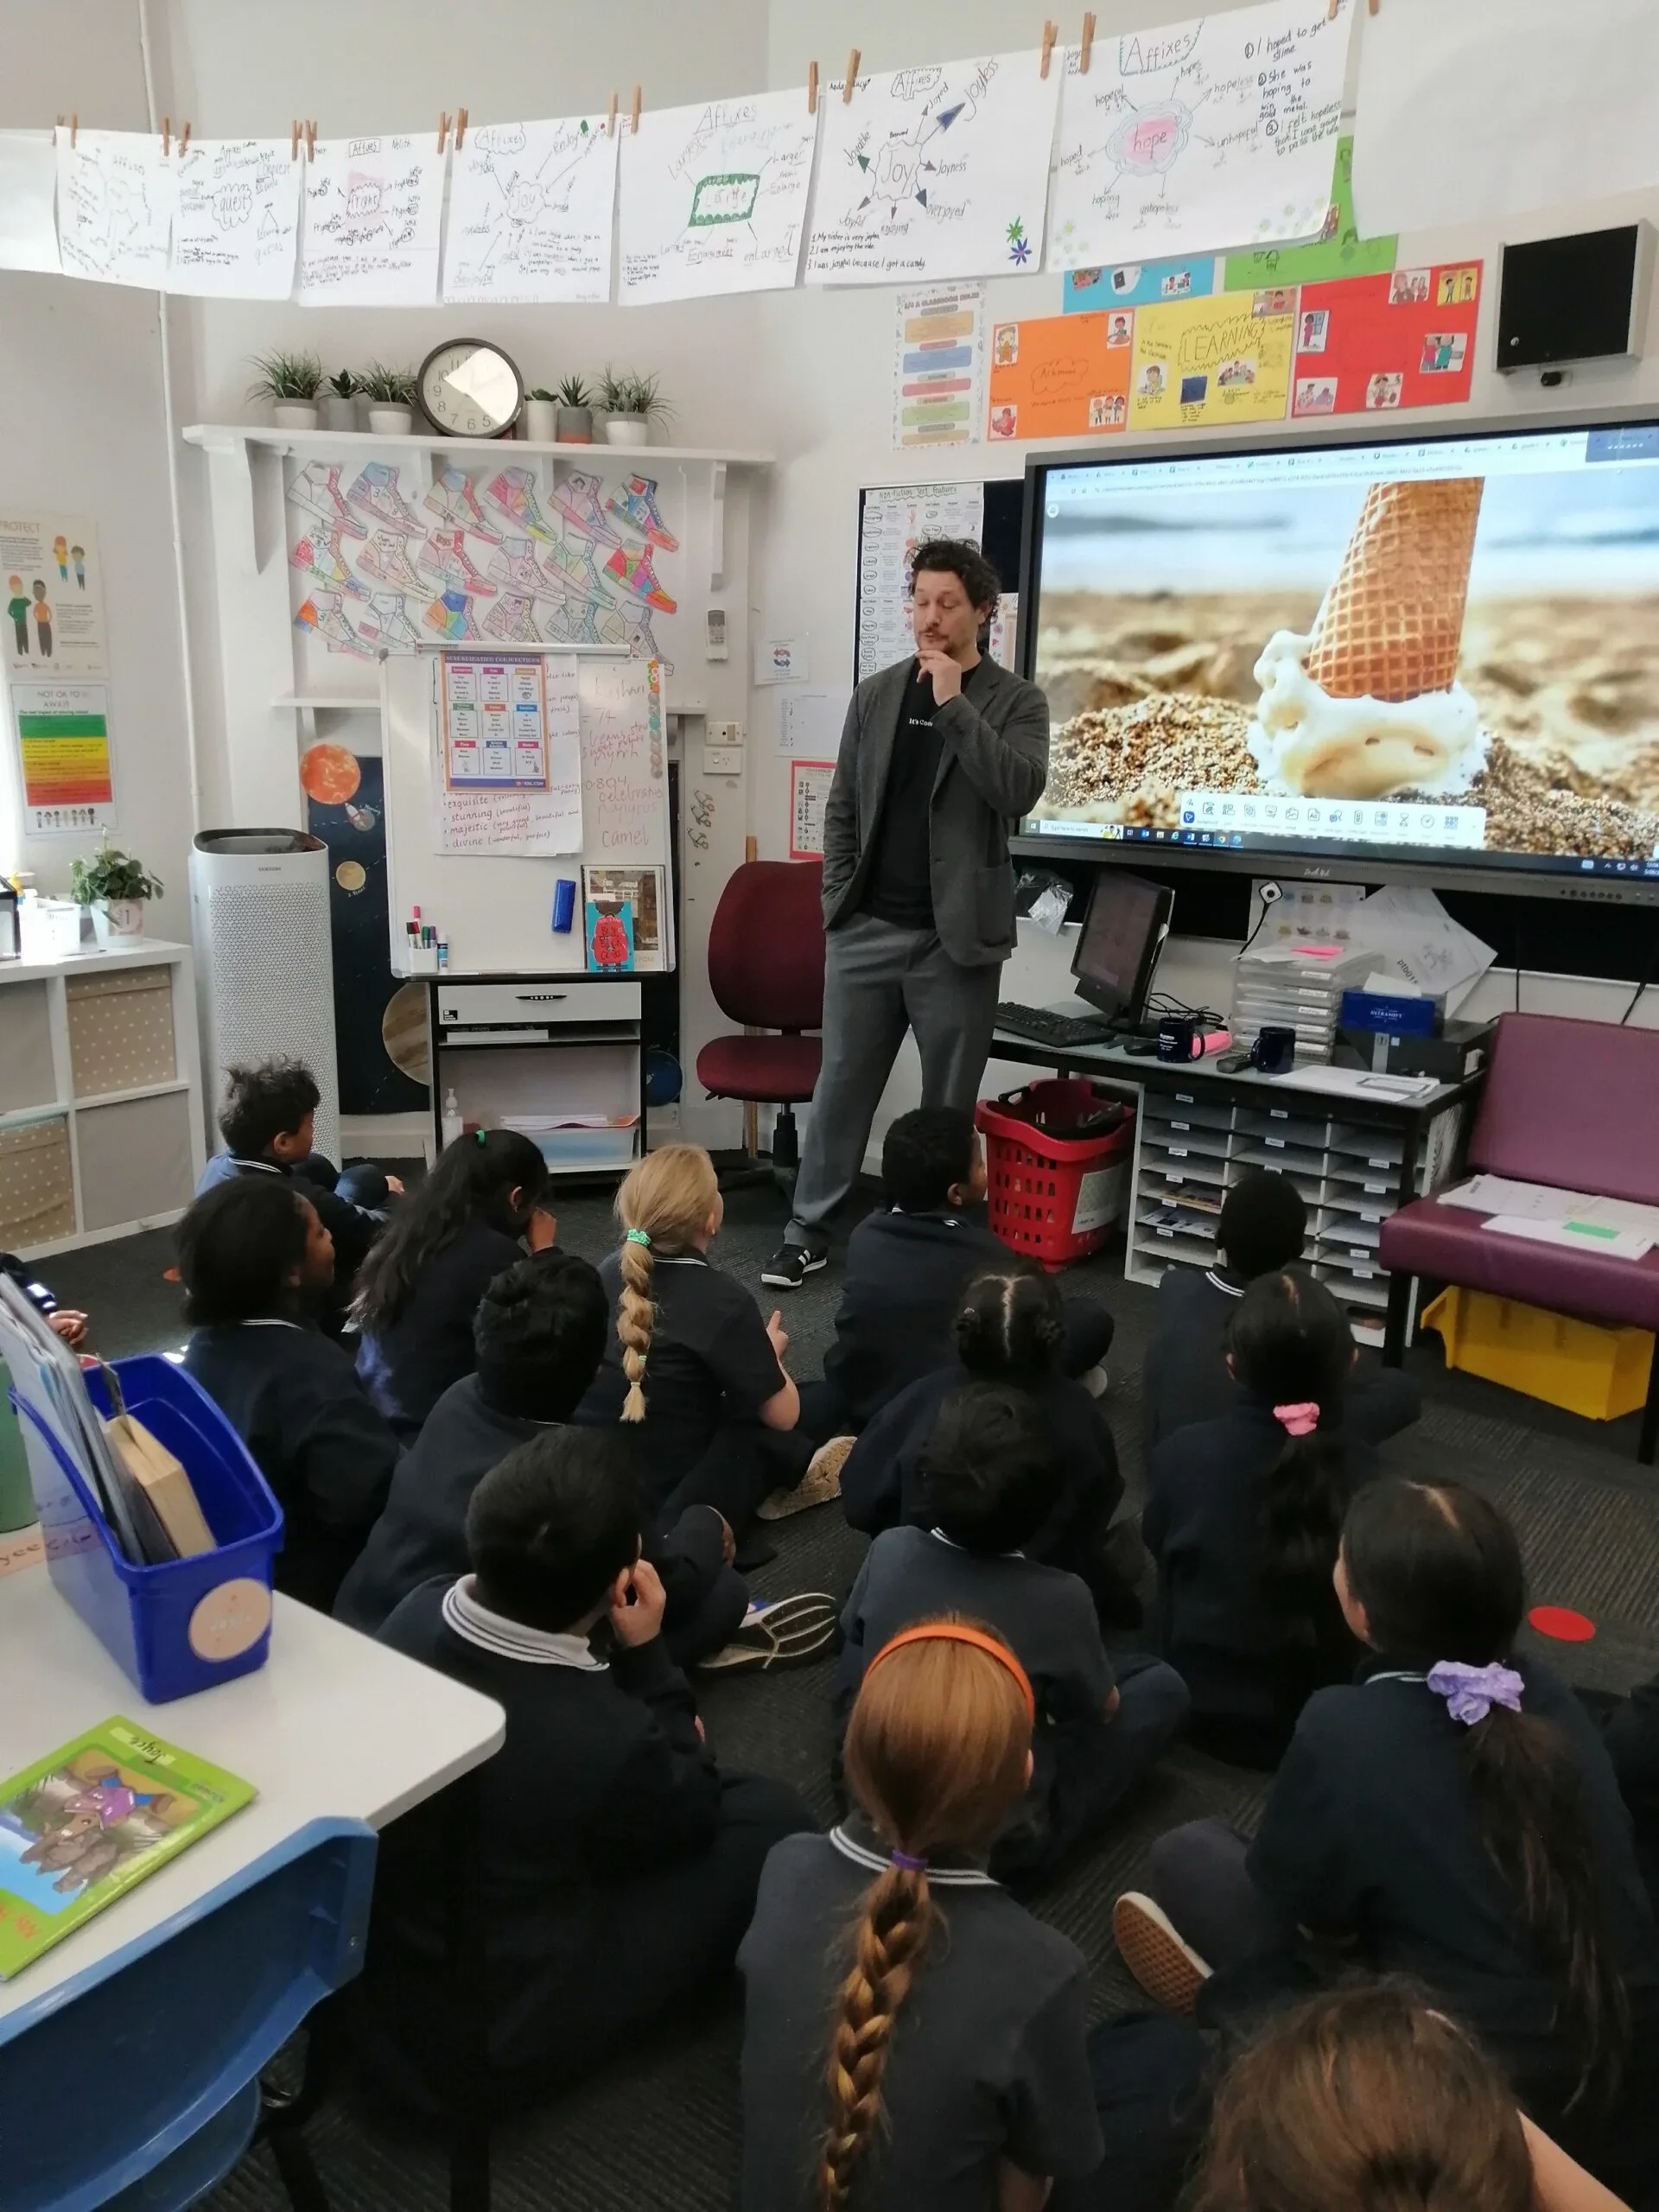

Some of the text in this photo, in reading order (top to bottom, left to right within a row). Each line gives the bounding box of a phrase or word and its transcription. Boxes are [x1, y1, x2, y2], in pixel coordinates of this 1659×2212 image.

[1267, 29, 1291, 54] hoped
[1297, 28, 1306, 37] to
[1310, 17, 1326, 37] get
[1124, 37, 1191, 73] Affixes
[1269, 60, 1312, 84] She was
[894, 73, 931, 97] Affixes
[1262, 78, 1311, 99] hoping to
[1291, 94, 1301, 104] the
[695, 104, 758, 134] Affixes
[1259, 108, 1276, 122] gold
[1288, 112, 1307, 133] felt
[1311, 100, 1342, 121] hopeless
[1301, 125, 1316, 137] was
[1320, 115, 1338, 130] going
[480, 130, 523, 147] Affixes
[1134, 124, 1166, 159] hope
[1289, 138, 1307, 153] pass
[1060, 144, 1083, 166] hoped
[881, 149, 916, 194] Joy
[1092, 194, 1120, 208] hoping
[219, 195, 248, 225] quest
[852, 234, 863, 243] very
[830, 245, 853, 253] enjoying
[852, 258, 880, 268] because
[887, 259, 898, 270] got
[1184, 322, 1260, 362] LEARNING
[438, 370, 448, 381] 10
[433, 385, 442, 397] 9
[437, 400, 446, 413] 8
[451, 414, 459, 424] 7
[467, 419, 476, 430] 6
[482, 415, 491, 427] 5
[932, 486, 957, 494] Features
[448, 797, 488, 810] exquisite
[451, 809, 493, 822] stunning
[450, 823, 488, 836] majestic
[453, 839, 482, 849] divine
[1370, 1010, 1402, 1019] ULTRASOFT
